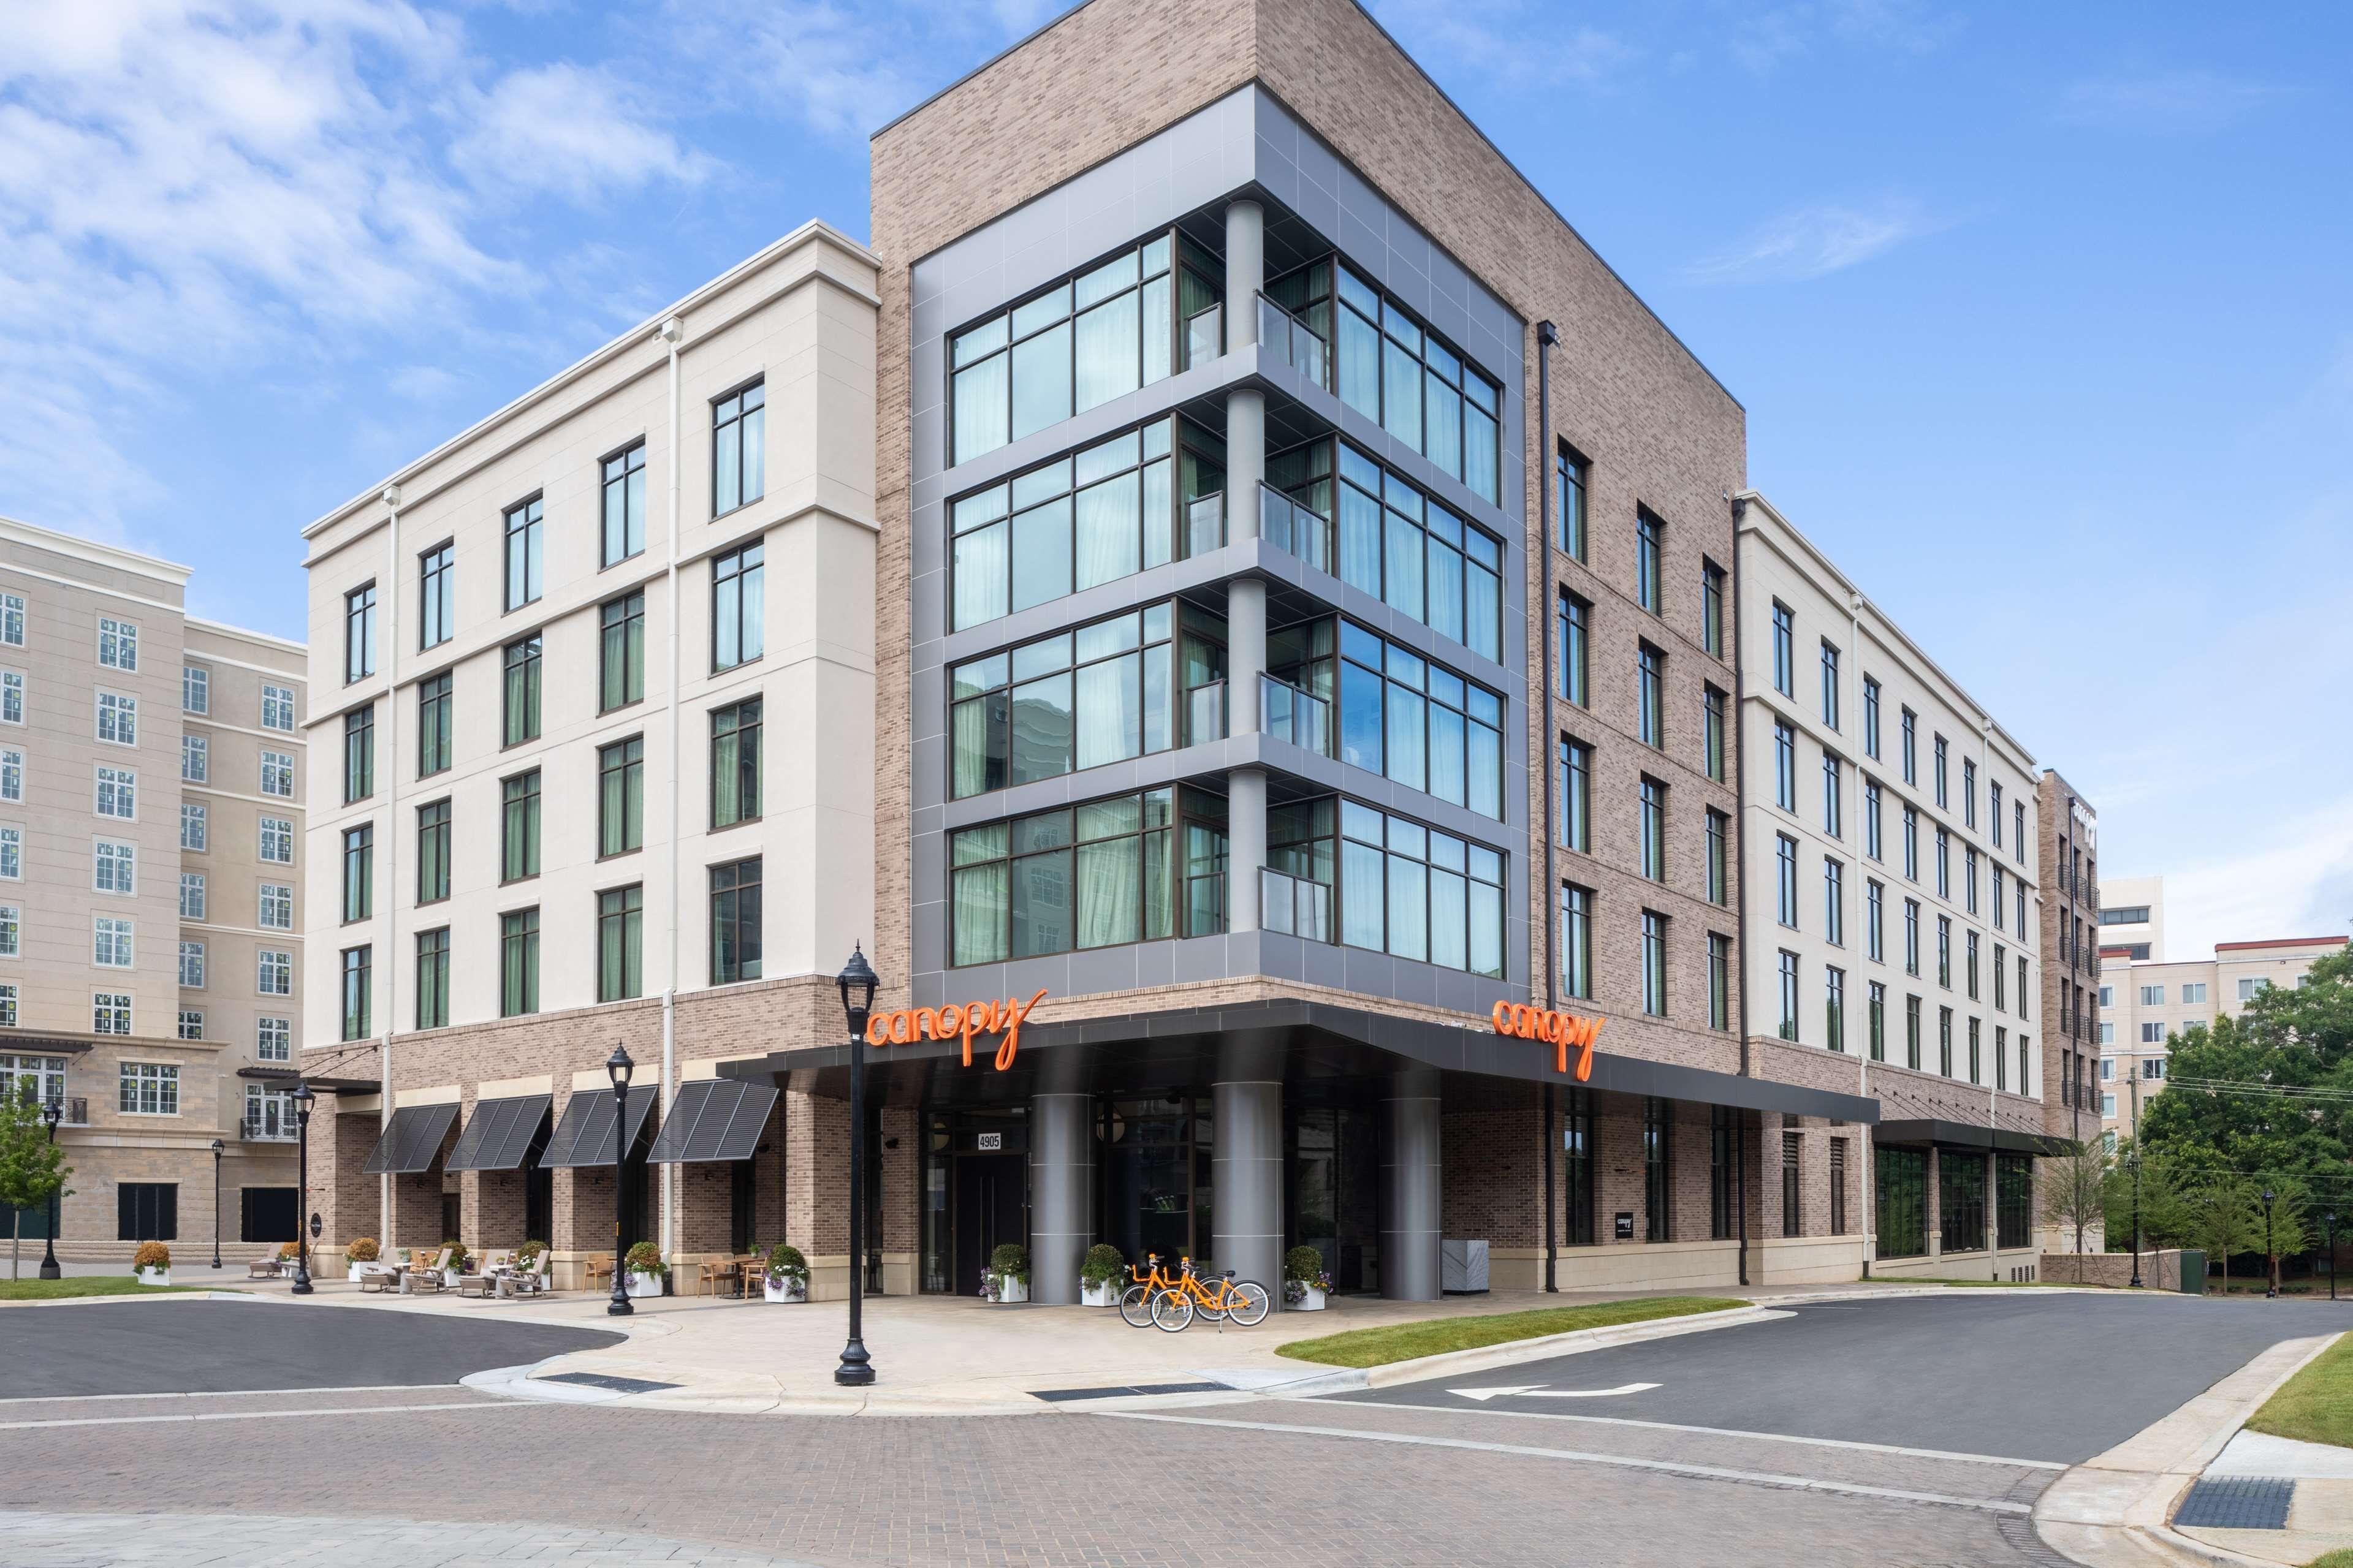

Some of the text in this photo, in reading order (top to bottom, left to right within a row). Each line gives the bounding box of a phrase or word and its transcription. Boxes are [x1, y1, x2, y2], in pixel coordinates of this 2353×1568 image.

[867, 989, 1047, 1070] canopy
[1492, 1000, 1606, 1081] canopy
[980, 1136, 999, 1147] 4905
